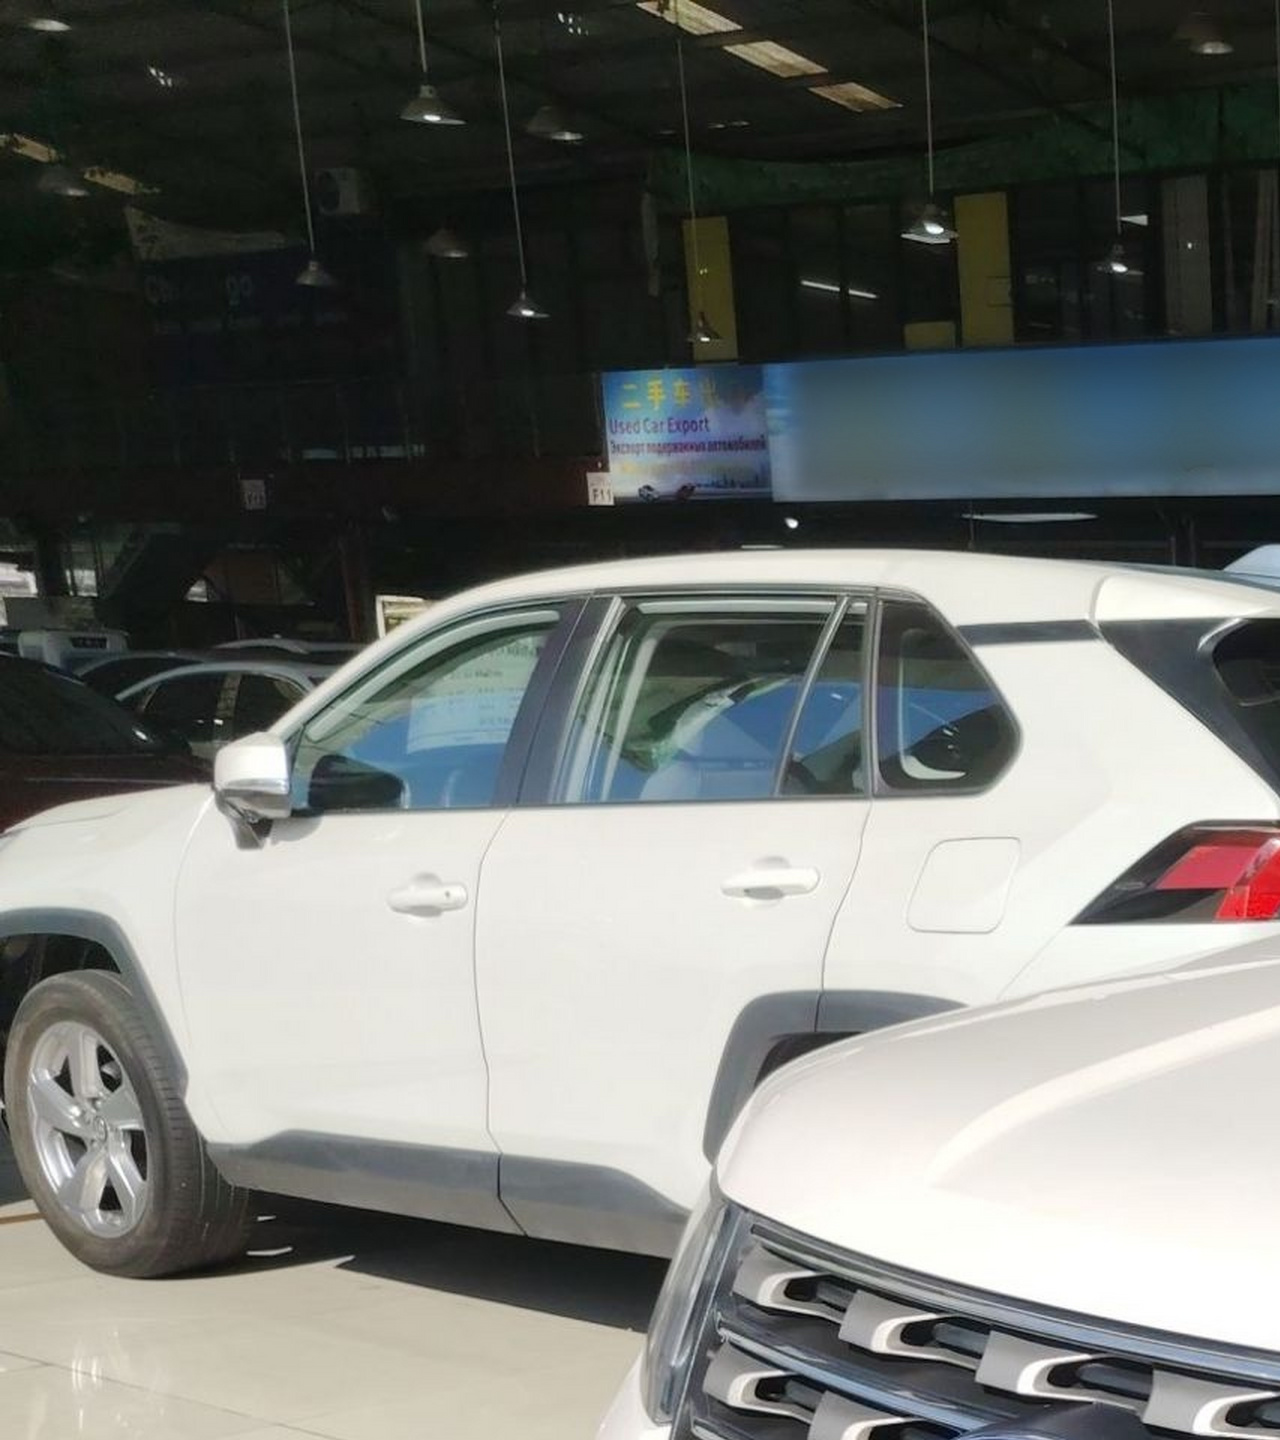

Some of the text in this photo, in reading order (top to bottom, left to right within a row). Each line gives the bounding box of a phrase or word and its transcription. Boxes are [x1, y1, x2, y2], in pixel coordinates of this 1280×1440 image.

[610, 416, 710, 436] Used Car Export
